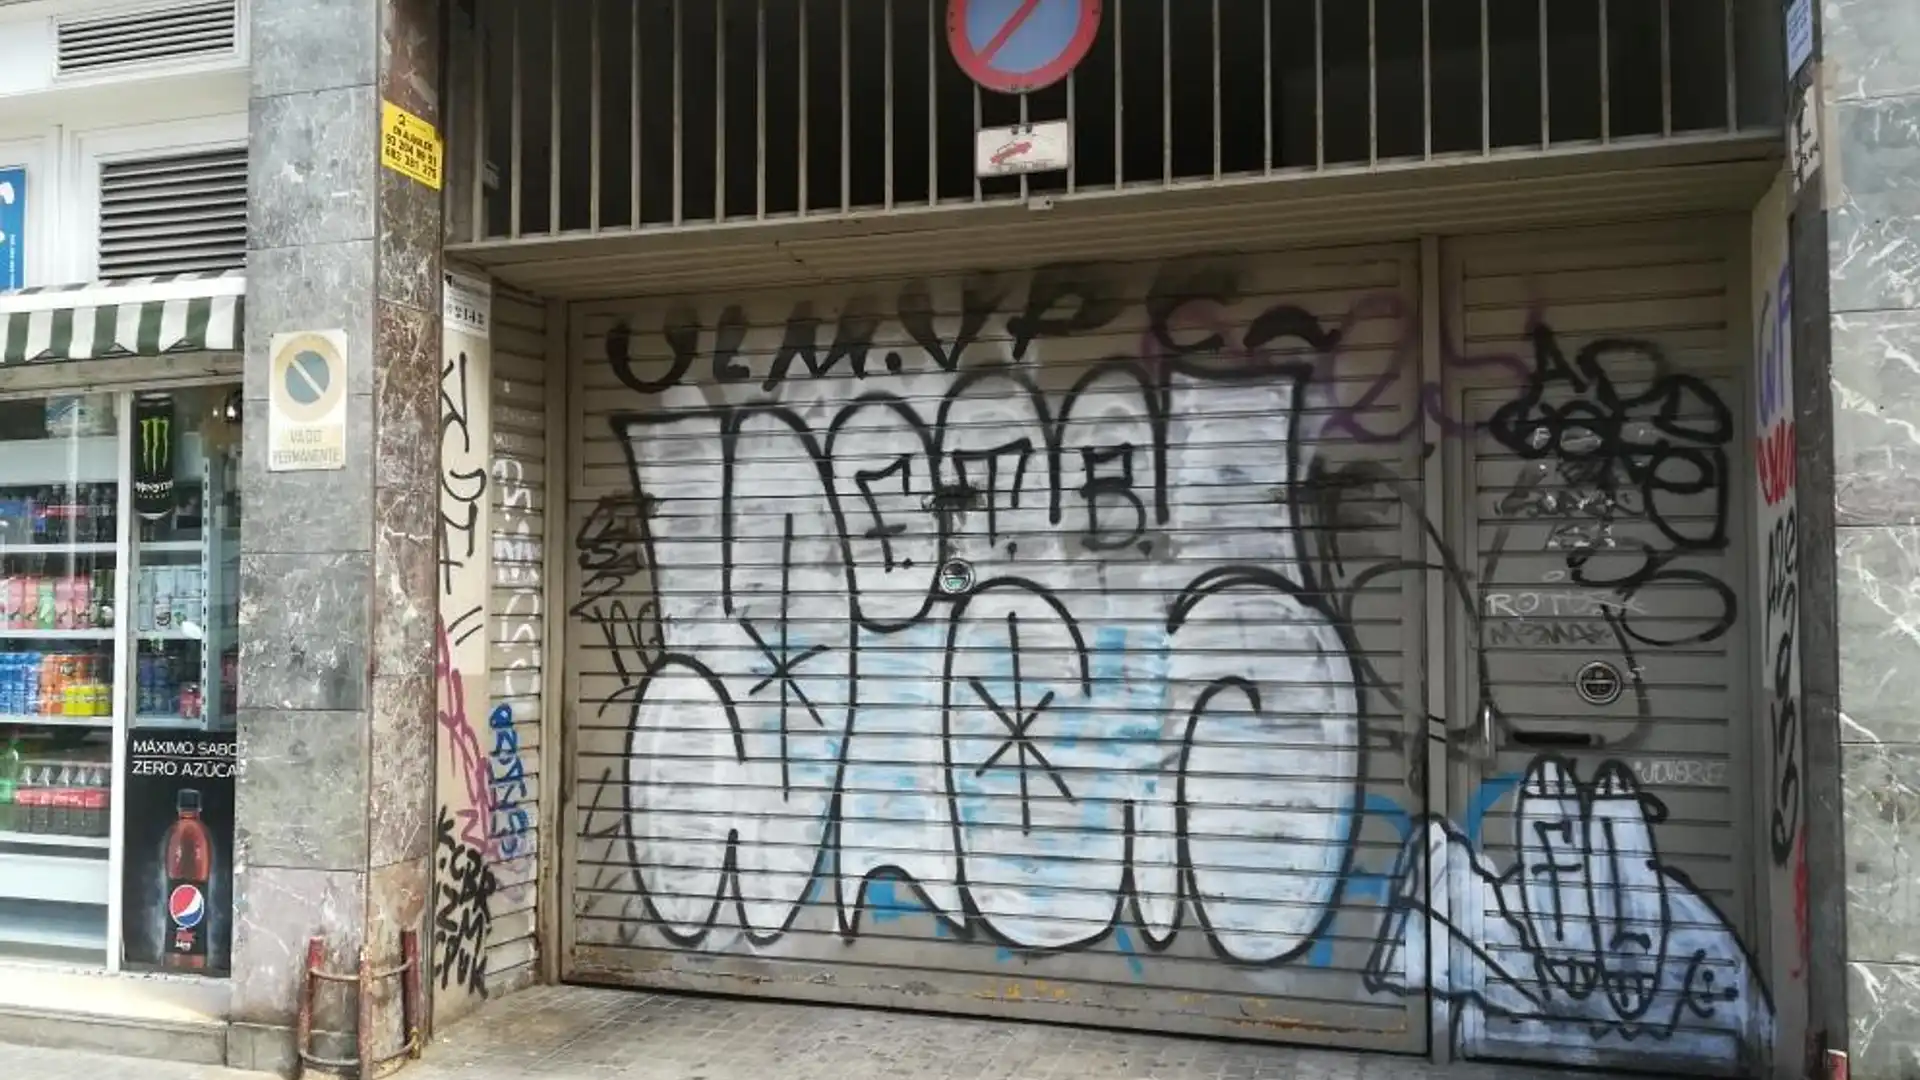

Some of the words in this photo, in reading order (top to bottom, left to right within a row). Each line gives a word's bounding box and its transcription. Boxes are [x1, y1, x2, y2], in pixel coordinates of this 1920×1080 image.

[133, 739, 195, 755] MÁXIMO
[197, 741, 240, 756] SABO
[131, 760, 177, 776] ZERO
[181, 760, 240, 778] AZÚCA
